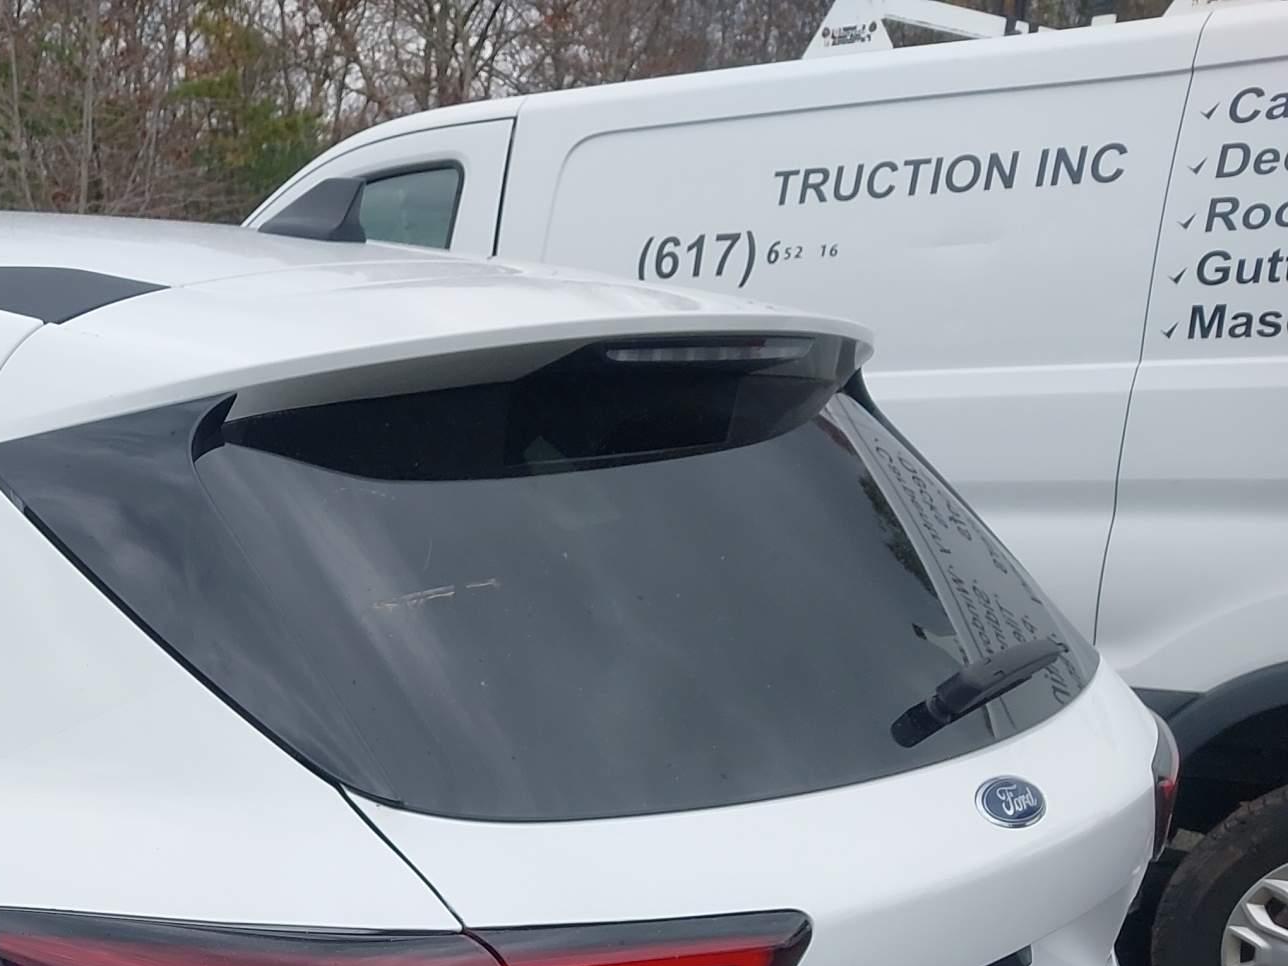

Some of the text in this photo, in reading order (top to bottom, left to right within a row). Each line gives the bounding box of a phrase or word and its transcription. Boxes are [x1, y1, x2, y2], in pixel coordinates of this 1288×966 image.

[774, 143, 1127, 206] TRUCTION INC
[1215, 142, 1288, 179] De
[638, 231, 756, 288] (617)
[1187, 303, 1288, 339] Mas
[996, 784, 1038, 815] Ford
